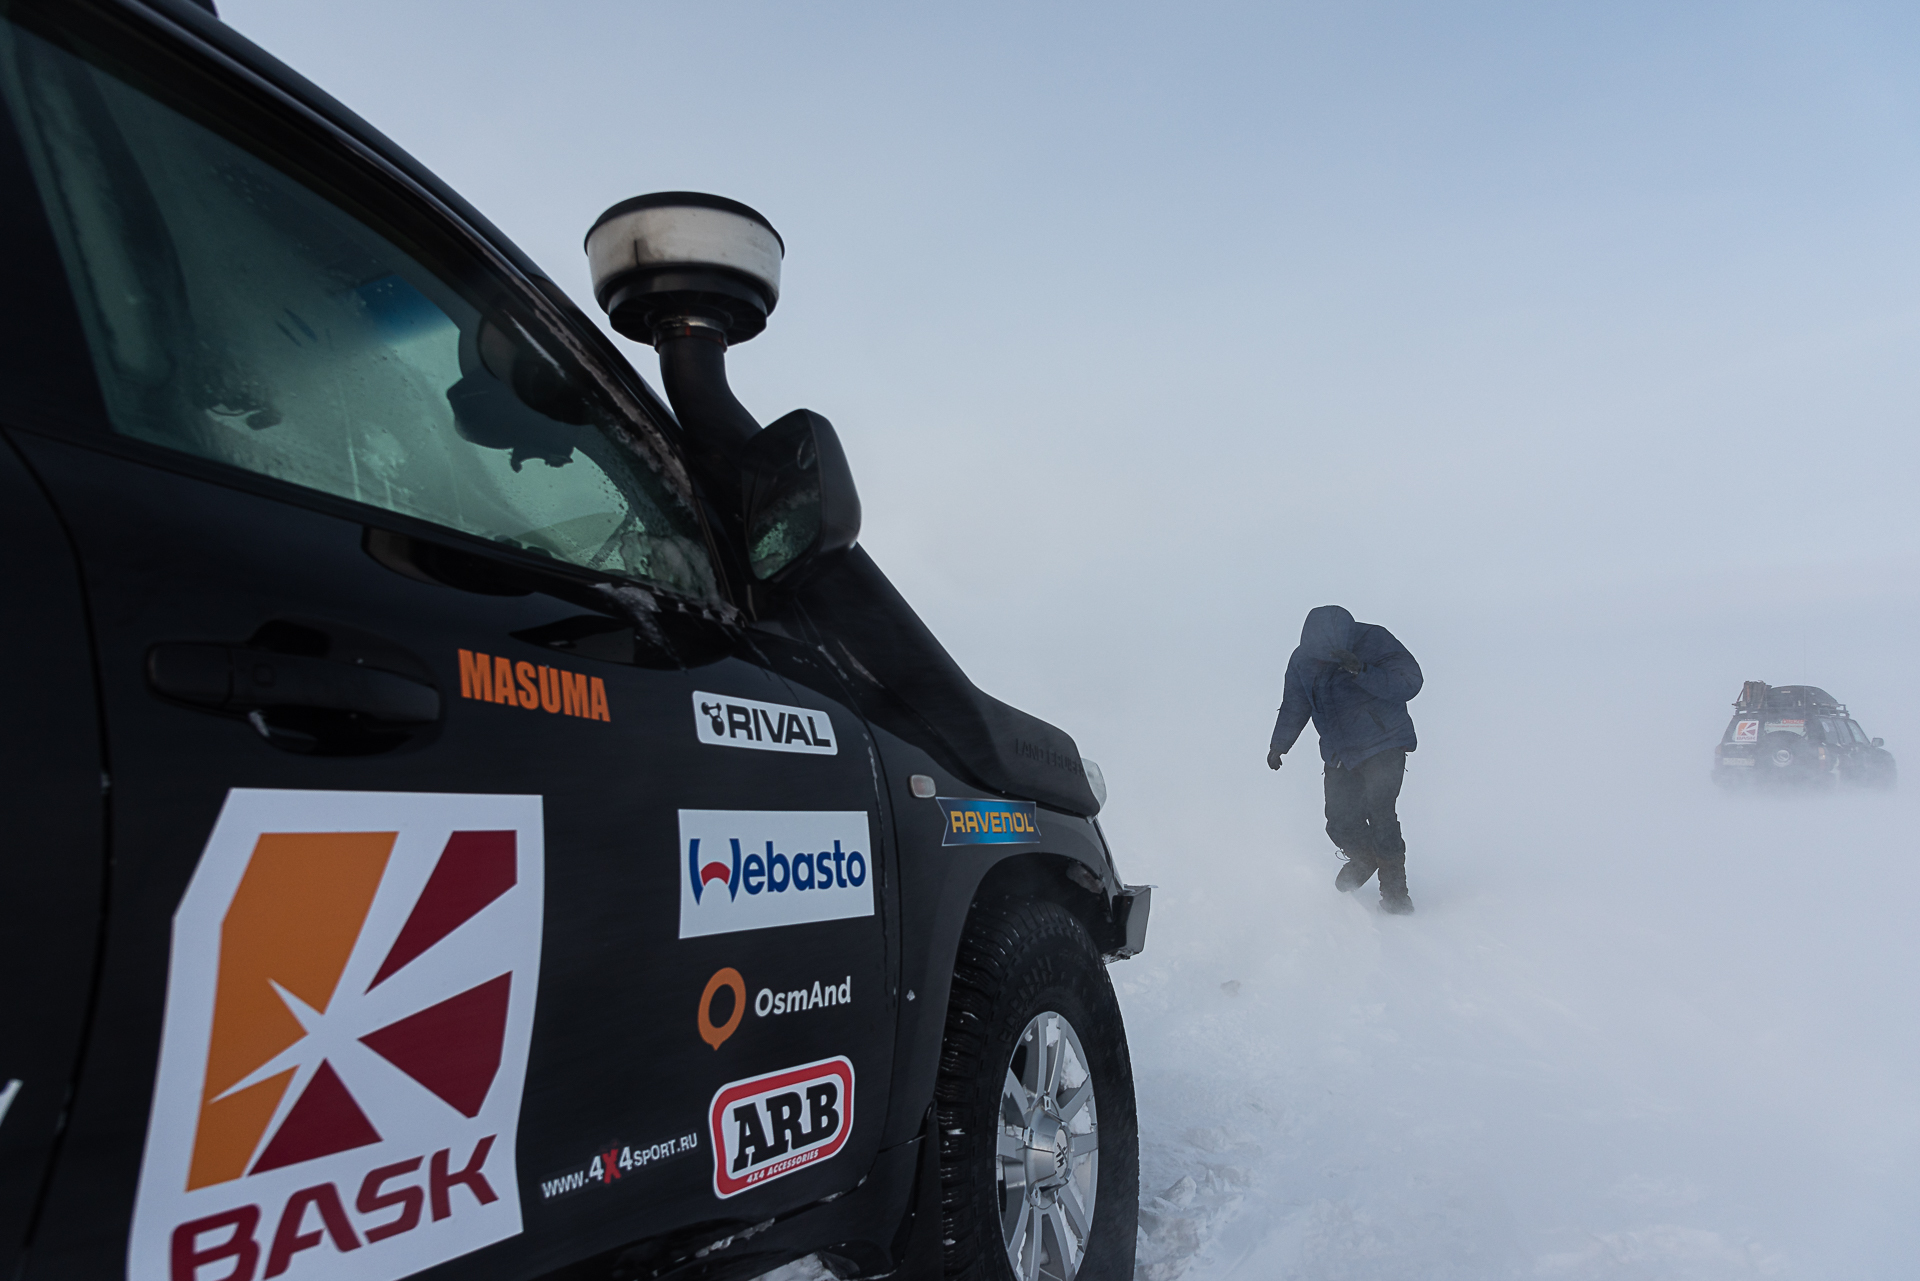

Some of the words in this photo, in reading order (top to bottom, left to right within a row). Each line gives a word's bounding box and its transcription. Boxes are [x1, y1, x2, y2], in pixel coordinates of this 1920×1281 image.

[458, 648, 611, 722] MASUMA
[726, 704, 831, 748] RIVAL
[950, 810, 1035, 834] RAVENOL
[688, 838, 867, 905] Webasto
[755, 976, 852, 1017] OsmAnd
[732, 1081, 840, 1174] ARB
[746, 1169, 765, 1183] 4X4
[767, 1149, 819, 1177] ACCESSORIES
[169, 1133, 499, 1281] BASK
